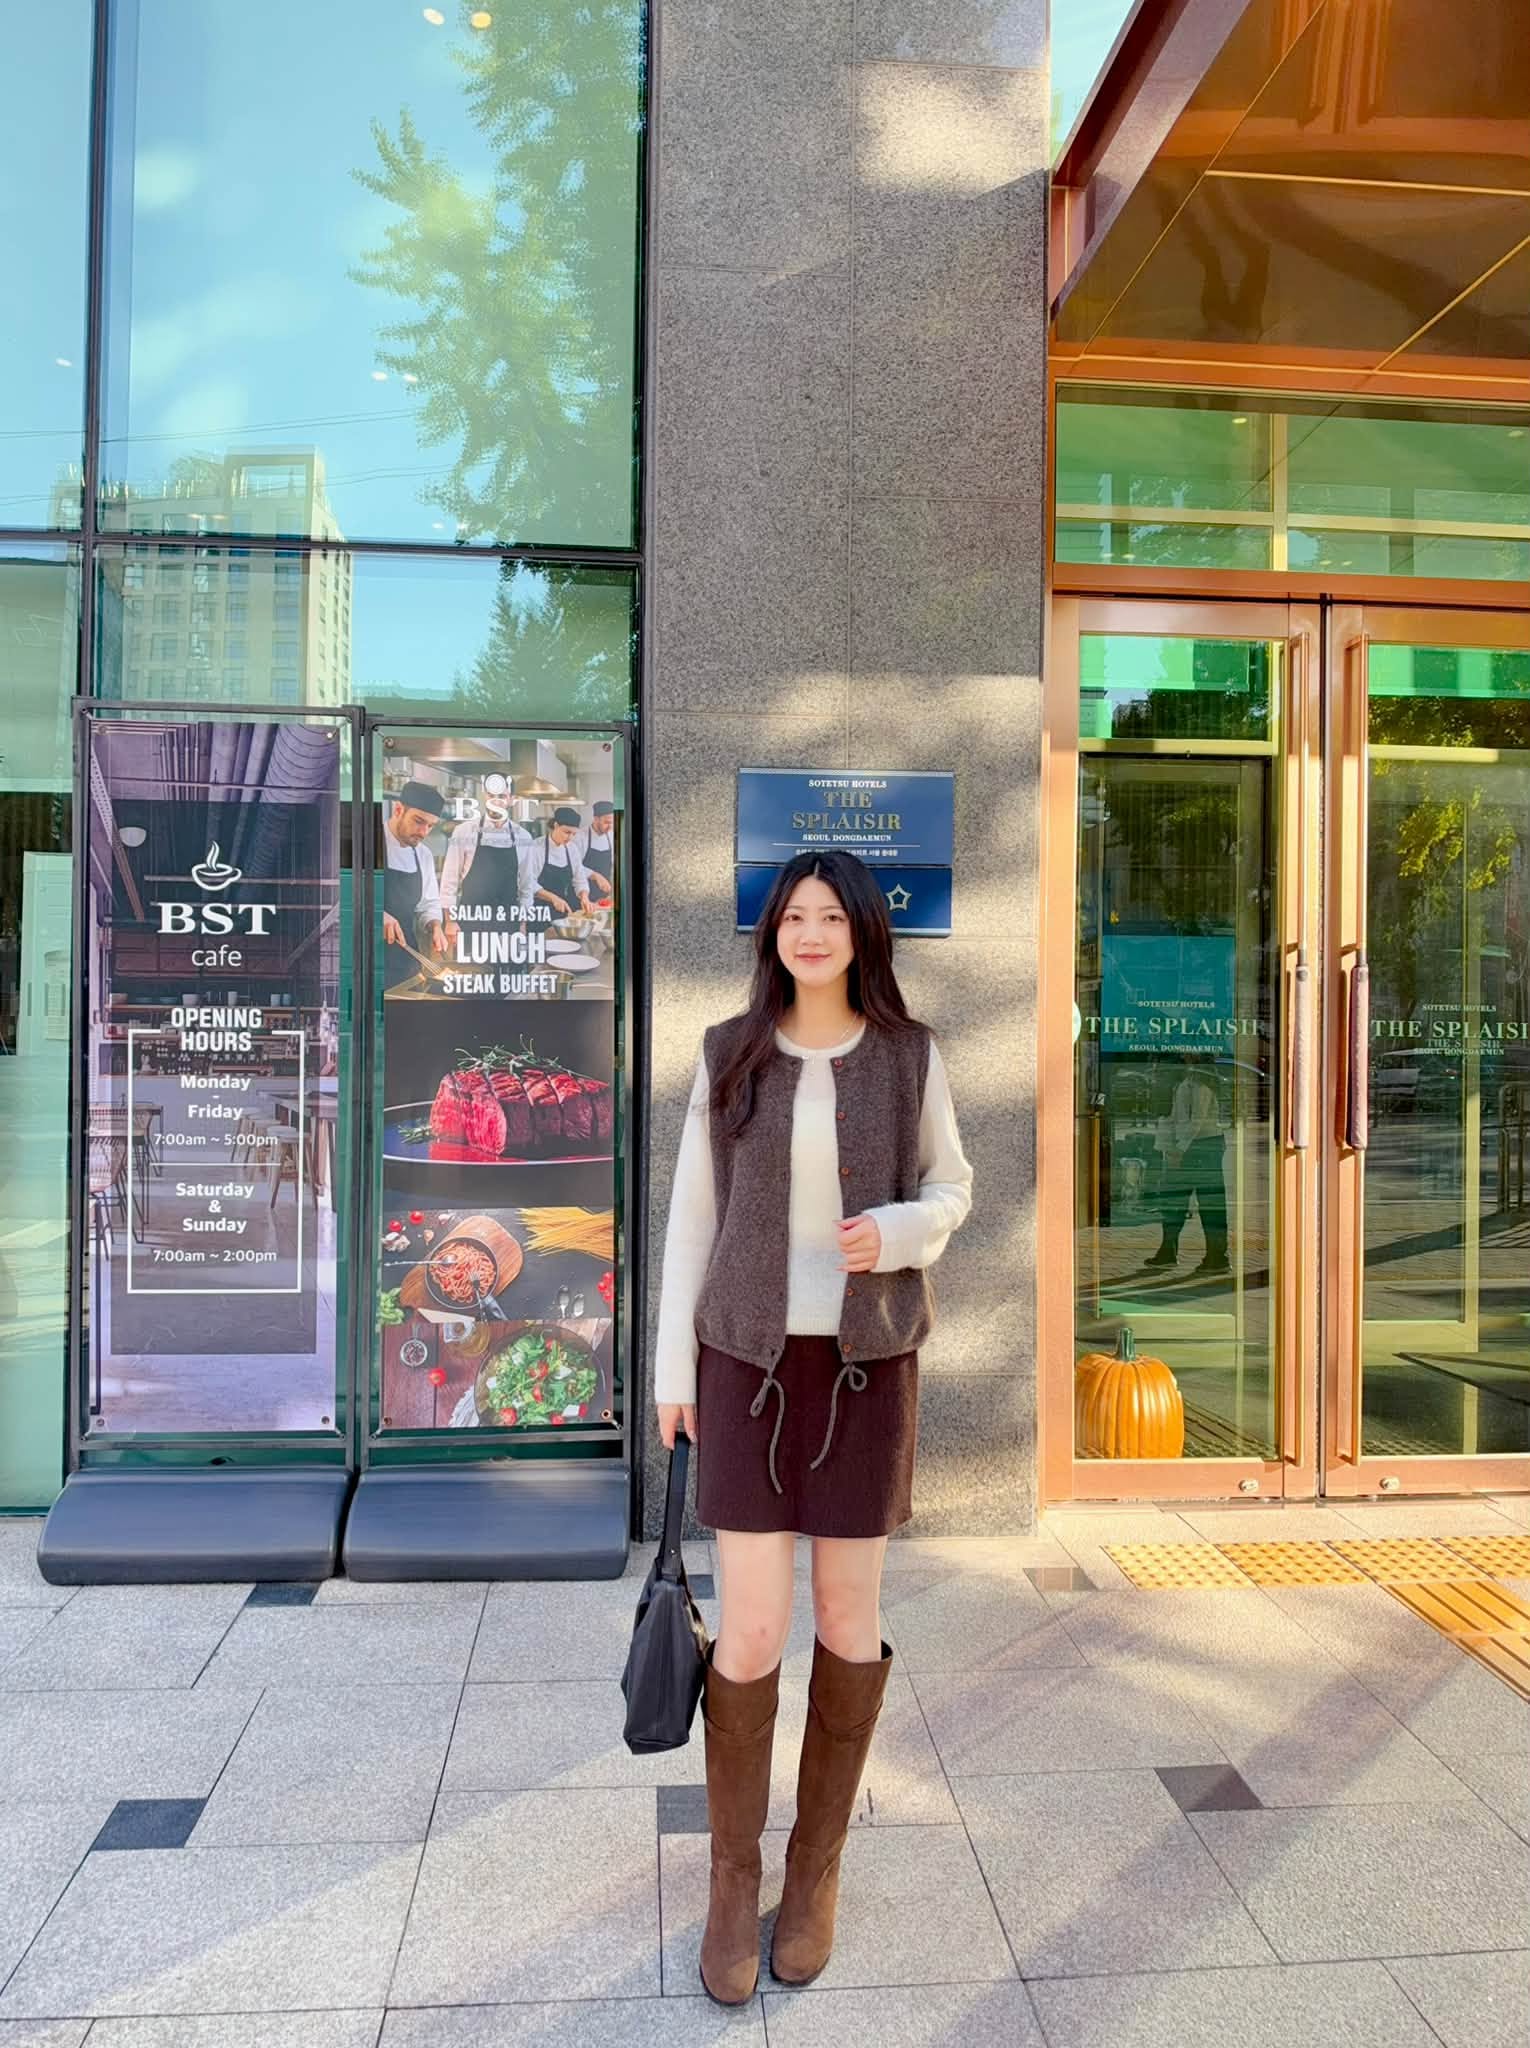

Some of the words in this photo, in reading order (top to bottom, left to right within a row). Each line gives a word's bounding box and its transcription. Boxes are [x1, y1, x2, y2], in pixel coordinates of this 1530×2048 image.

[808, 779, 850, 789] SOTETSU
[851, 780, 888, 789] HOTELS
[823, 790, 873, 809] THE
[453, 797, 540, 823] BST
[792, 811, 902, 831] SPLAISIR
[802, 833, 831, 842] SEOUL
[832, 833, 892, 842] DONGDAEMUN
[156, 902, 277, 936] BST
[449, 904, 492, 922] SALAD
[495, 905, 507, 922] &
[509, 905, 552, 922] PASTA
[191, 944, 243, 967] cafe
[456, 930, 547, 964] LUNCH
[442, 973, 496, 994] STEAK
[499, 974, 558, 994] BUFFET
[1137, 1000, 1179, 1009] SOTETSU
[1180, 1001, 1216, 1010] HOTELS
[171, 1007, 263, 1029] OPENING
[1085, 1016, 1138, 1035] THE
[1371, 1019, 1423, 1039] THE
[1432, 1020, 1530, 1039] SPLAISI
[181, 1030, 253, 1052] HOURS
[1128, 1044, 1159, 1053] SEOUL
[1160, 1045, 1225, 1054] DONGDAEMUN
[180, 1074, 252, 1091] Monday
[187, 1103, 244, 1121] Friday
[153, 1133, 207, 1145] 7:00am
[223, 1133, 279, 1148] 5:00pm
[175, 1182, 255, 1199] Saturday
[208, 1199, 222, 1213] &
[182, 1217, 248, 1234] Sunday
[152, 1249, 206, 1262] 7:00am
[223, 1249, 278, 1264] 2:00pm
